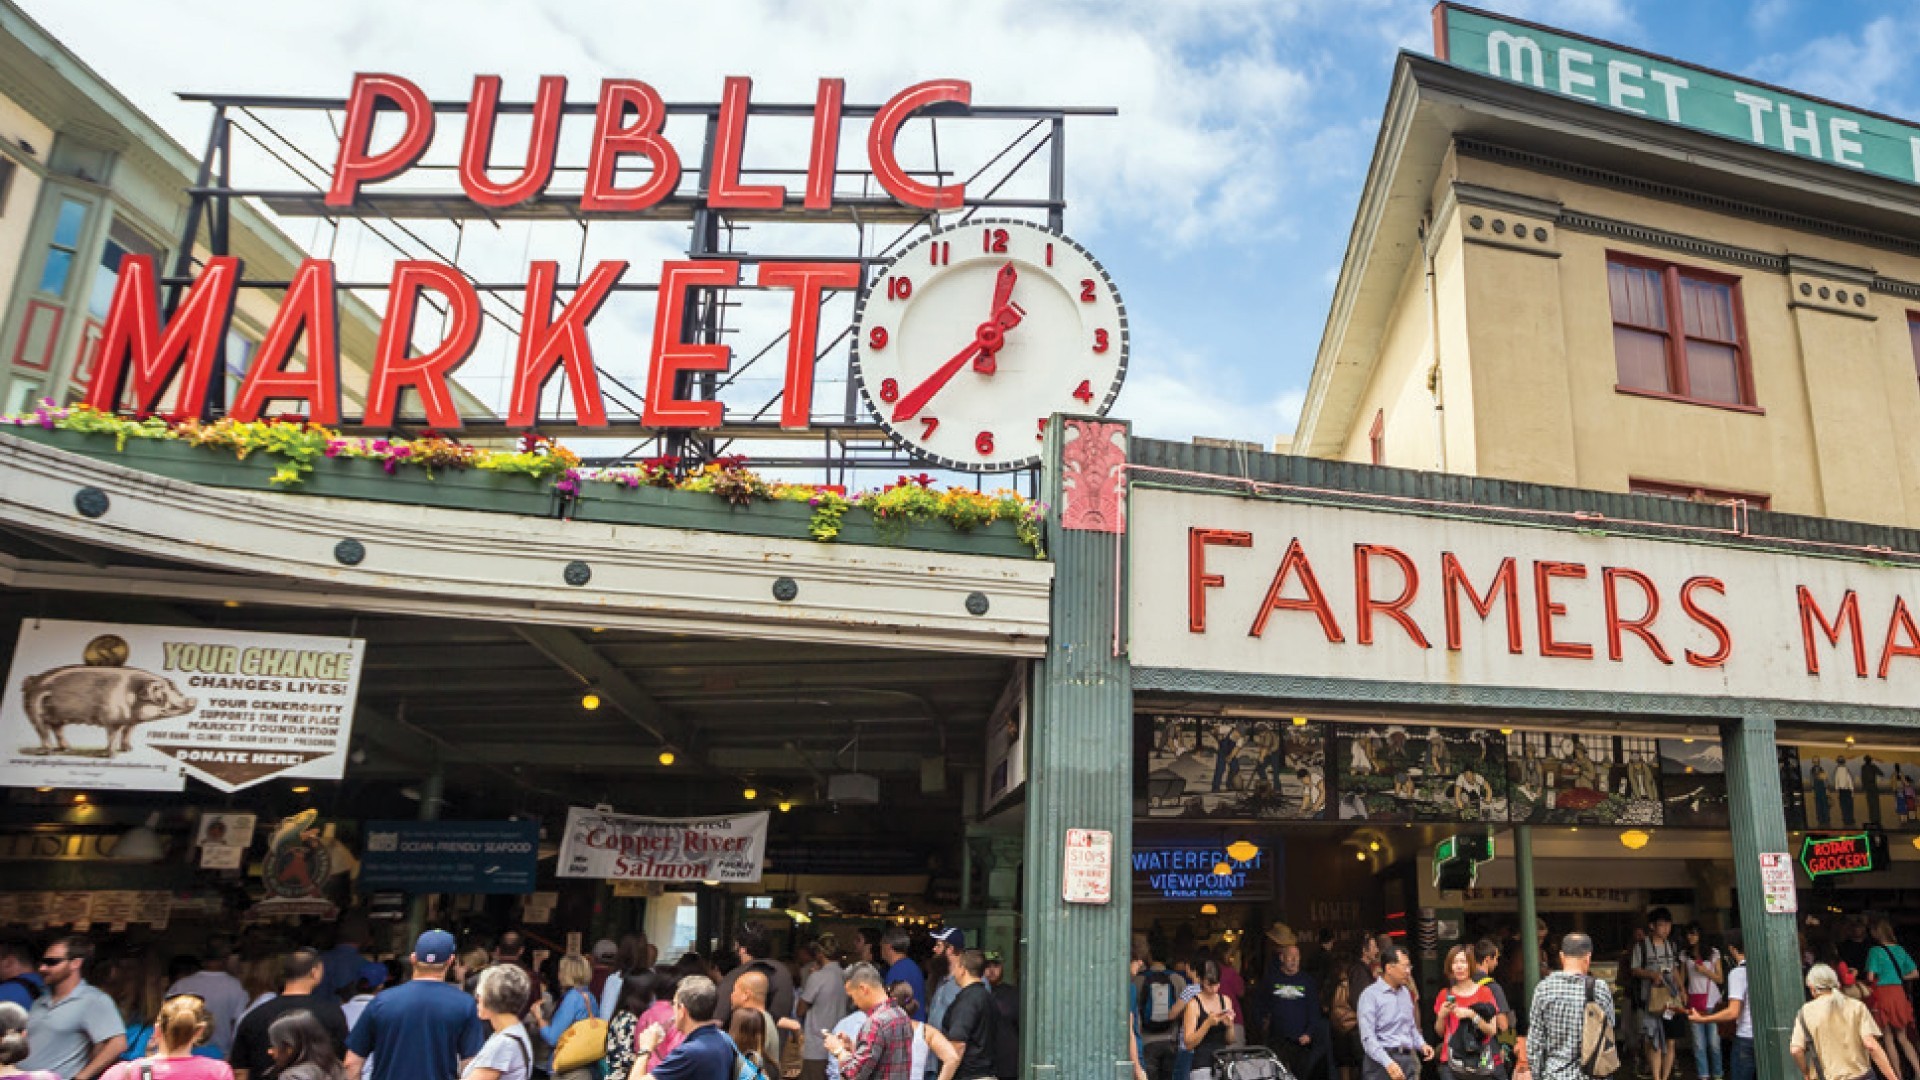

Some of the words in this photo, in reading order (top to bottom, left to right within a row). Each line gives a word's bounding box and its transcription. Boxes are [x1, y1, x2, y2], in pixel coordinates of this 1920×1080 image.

[1487, 30, 1689, 122] MEET
[1734, 90, 1865, 169] THE
[326, 72, 972, 212] PUBLIC
[983, 228, 1010, 253] 12
[930, 240, 949, 266] 11
[1046, 243, 1054, 267] 1
[887, 277, 912, 301] 10
[1080, 279, 1096, 302] 2
[84, 254, 860, 430] MARKET
[869, 326, 889, 350] 9
[1092, 328, 1110, 353] 3
[880, 378, 899, 403] 8
[1072, 380, 1094, 403] 4
[920, 417, 940, 440] 7
[975, 431, 994, 455] 6
[1187, 526, 1733, 668] FARMERS
[1797, 583, 1920, 680] MA
[163, 642, 239, 674] YOUR
[241, 647, 353, 680] CHANGE
[188, 676, 281, 691] CHANGES
[286, 681, 347, 695] LIVES!
[199, 709, 255, 721] SUPPORTS
[259, 713, 278, 723] THE
[308, 716, 341, 726] PLACE
[209, 698, 247, 709] YOUR
[252, 700, 343, 713] GENEROSITY
[188, 721, 245, 731] MARKET
[249, 723, 339, 736] FOUNDATION
[176, 749, 249, 764] DONATE
[251, 751, 304, 765] HERE!
[587, 828, 674, 856] Copper
[684, 831, 750, 851] River
[614, 854, 711, 879] Salmon
[1809, 853, 1868, 872] GROCERY
[1149, 872, 1247, 889] VIEWPOINT
